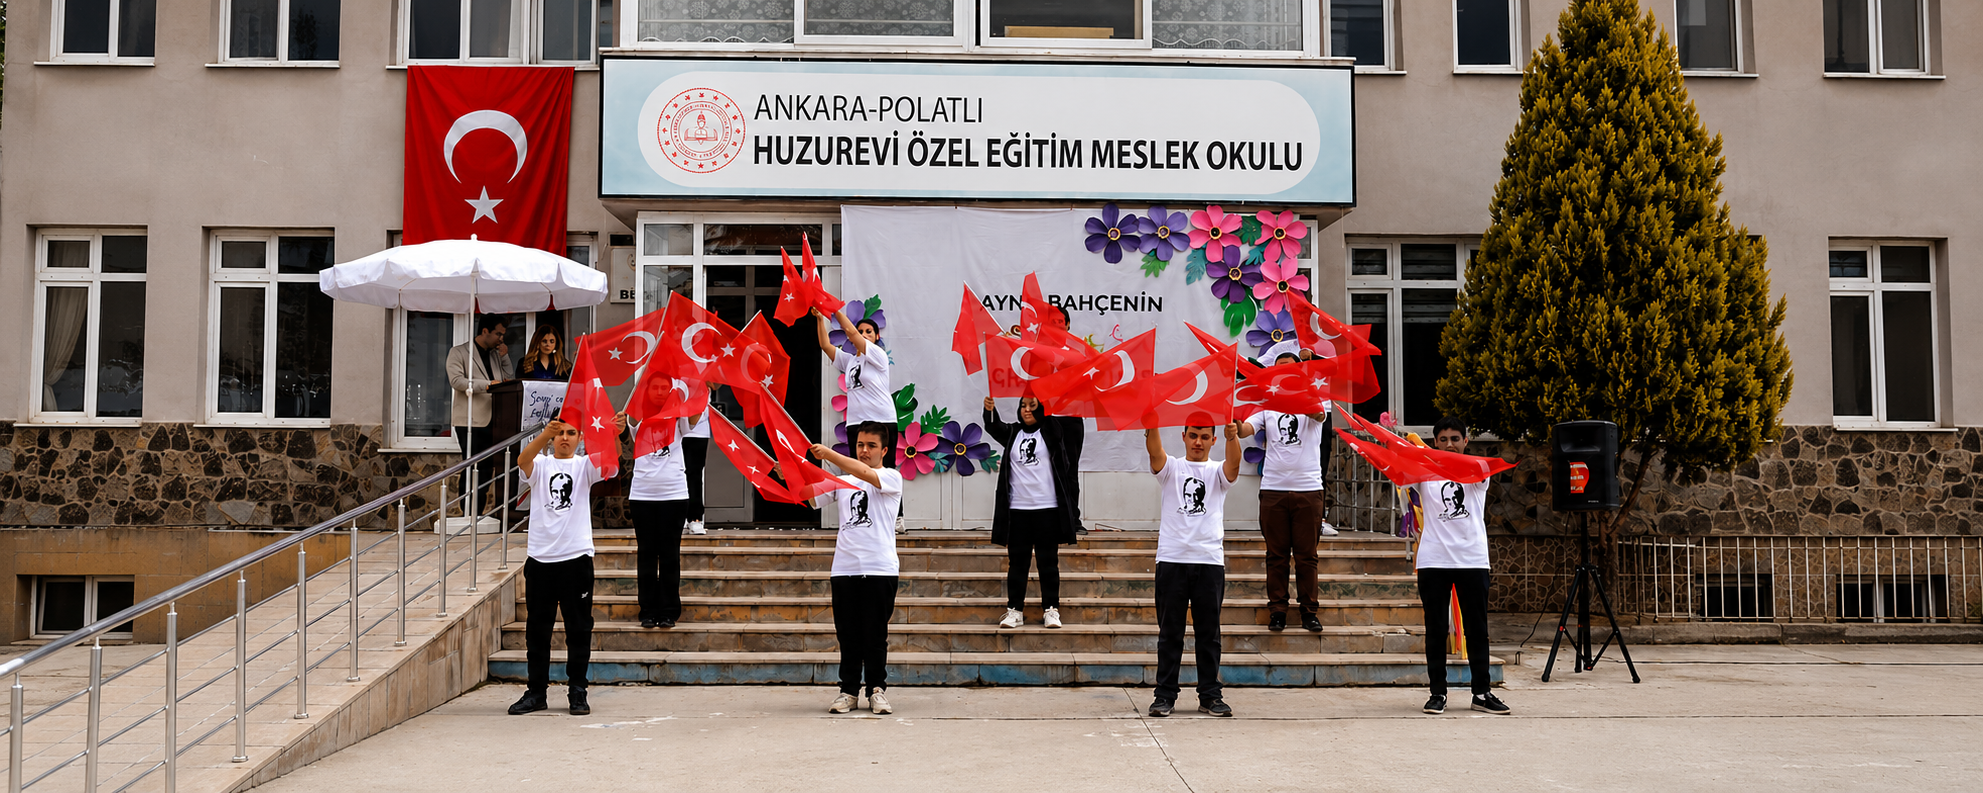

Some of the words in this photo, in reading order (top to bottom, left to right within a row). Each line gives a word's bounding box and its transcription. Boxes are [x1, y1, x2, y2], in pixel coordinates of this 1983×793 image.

[754, 94, 983, 123] ANKARA-POLATLI
[754, 130, 899, 166] HUZUREVİ
[907, 130, 980, 167] ÖZEL
[986, 131, 1083, 168] EĞİTİM
[1091, 139, 1200, 170] MESLEK
[1206, 140, 1303, 171] OKULU
[980, 294, 1023, 313] AYN
[1048, 291, 1163, 316] BAHÇENİN
